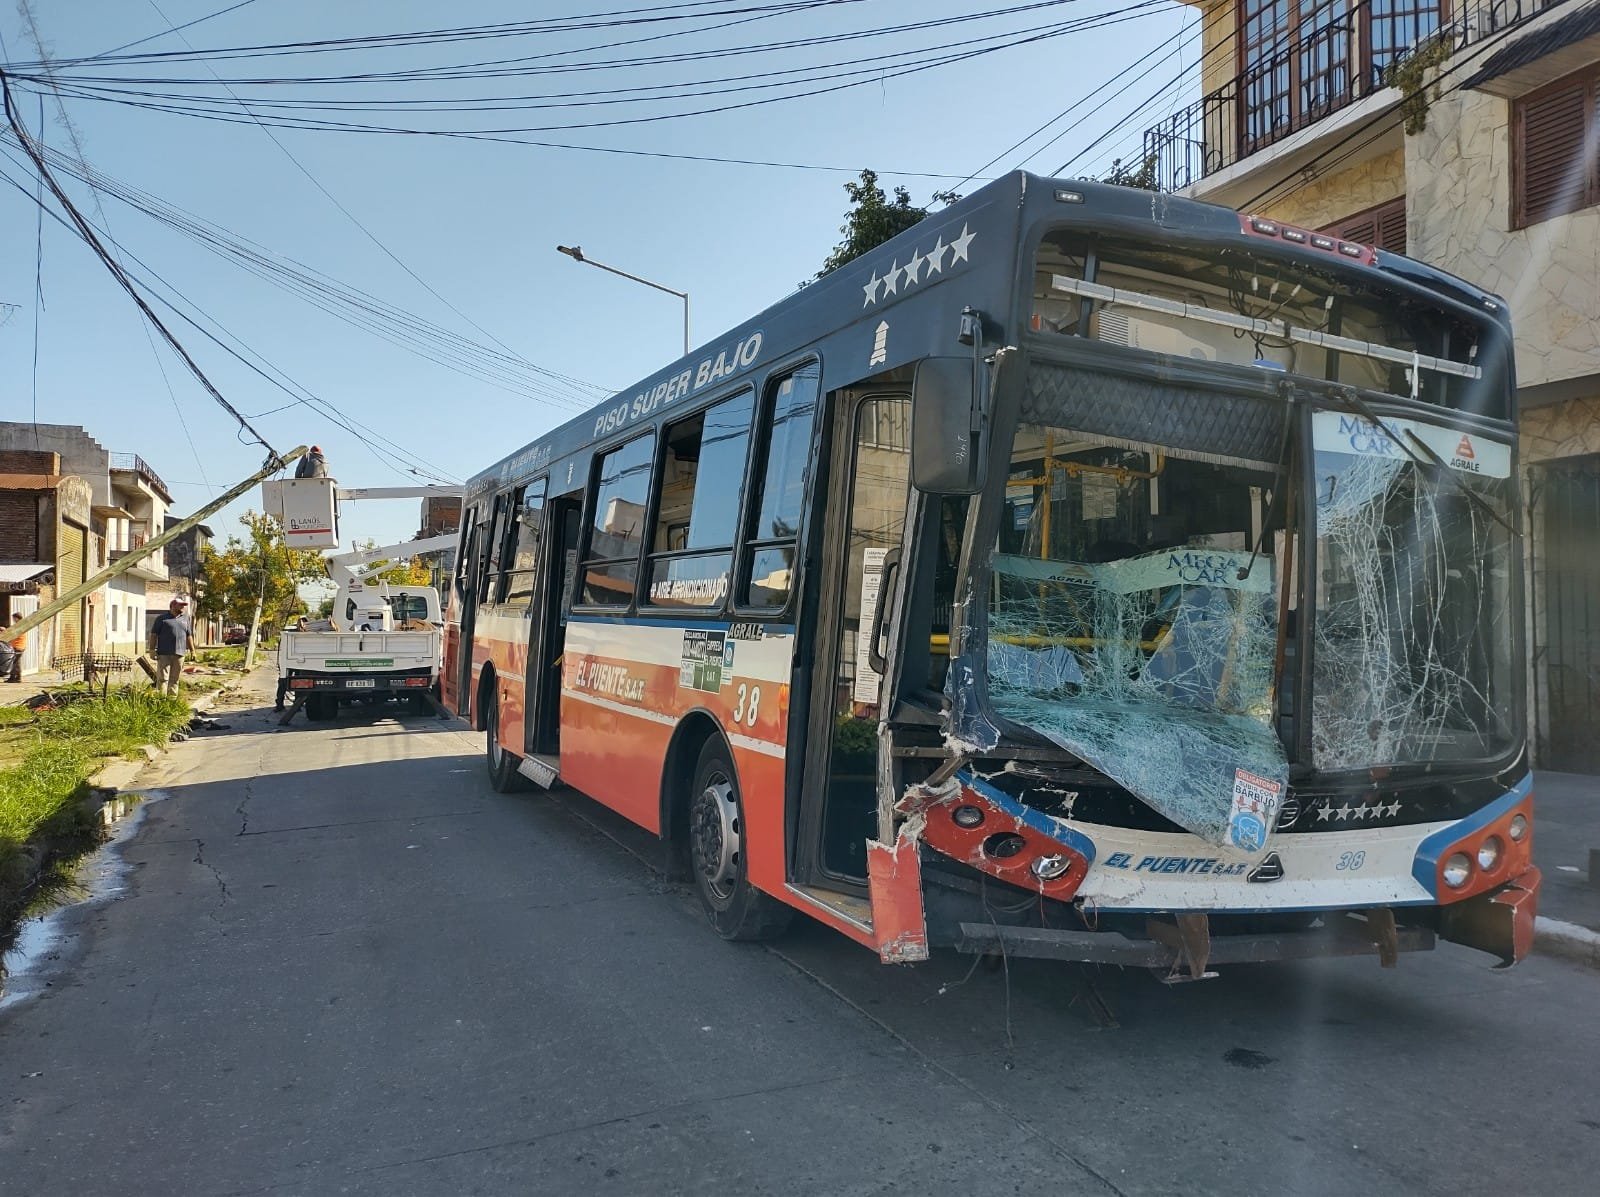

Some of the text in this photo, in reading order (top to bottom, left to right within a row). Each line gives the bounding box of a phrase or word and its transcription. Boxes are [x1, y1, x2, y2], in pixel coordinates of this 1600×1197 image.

[593, 332, 763, 438] PISO SUPER BAJO
[1350, 433, 1394, 455] CAR
[1450, 458, 1481, 473] AGRALE
[1166, 552, 1238, 569] MEGA
[1179, 566, 1229, 584] CAR
[727, 623, 764, 640] AGRALE
[575, 660, 587, 687] EL
[587, 662, 628, 697] PUENTE
[733, 682, 760, 728] 38
[1238, 770, 1278, 792] OBLIGATORIO
[1235, 784, 1275, 808] BARBIJO
[1103, 851, 1133, 869] EL
[1136, 855, 1217, 875] PUENTE
[1336, 850, 1366, 871] 38
